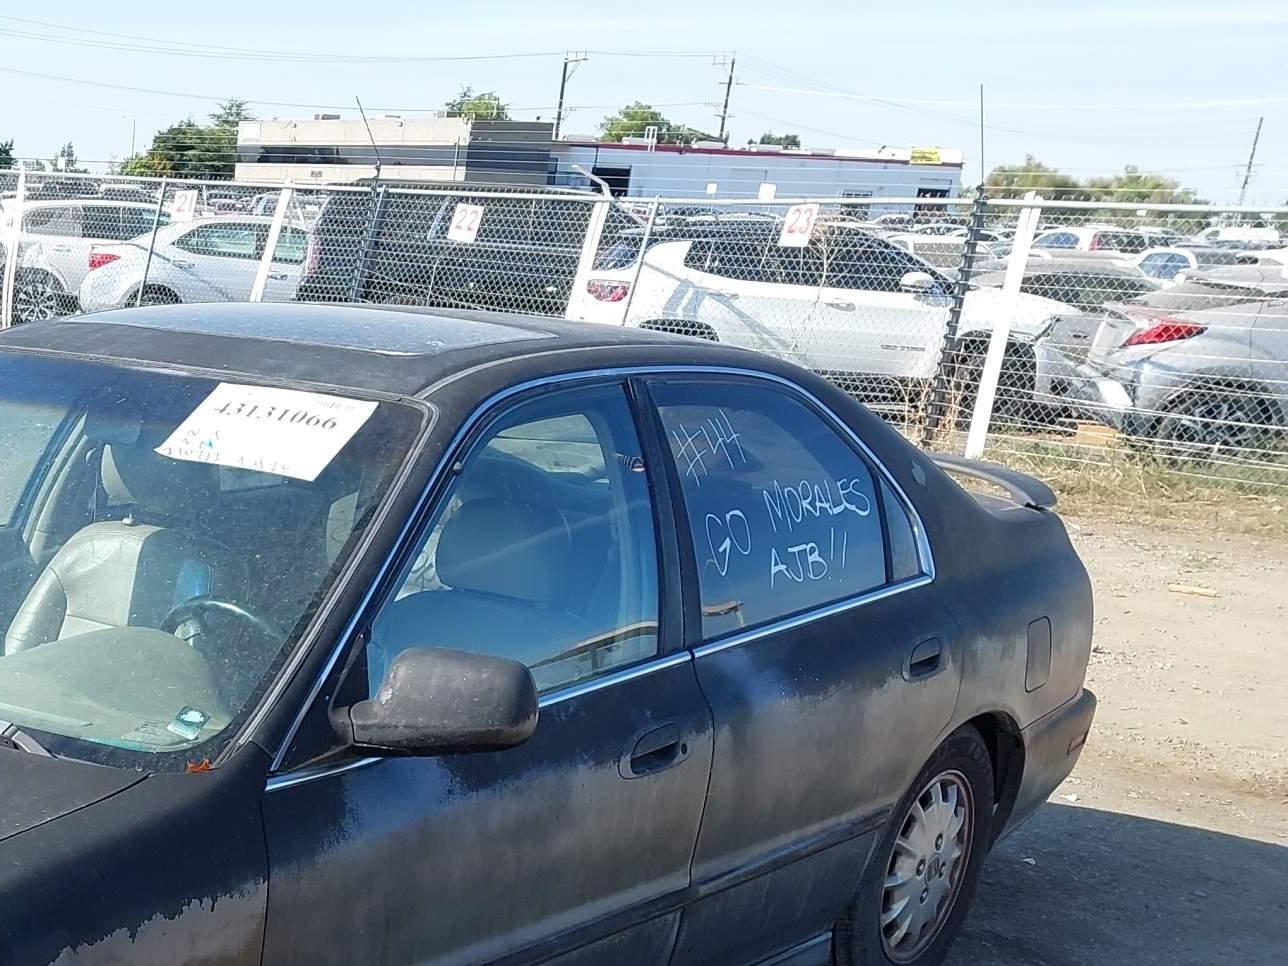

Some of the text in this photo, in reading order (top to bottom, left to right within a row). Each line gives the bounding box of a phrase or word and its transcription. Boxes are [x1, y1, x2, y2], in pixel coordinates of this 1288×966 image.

[175, 192, 195, 213] 21
[454, 207, 480, 232] 22
[786, 207, 814, 234] 23
[213, 400, 337, 431] 43131066
[705, 478, 871, 577] GO MORALES
